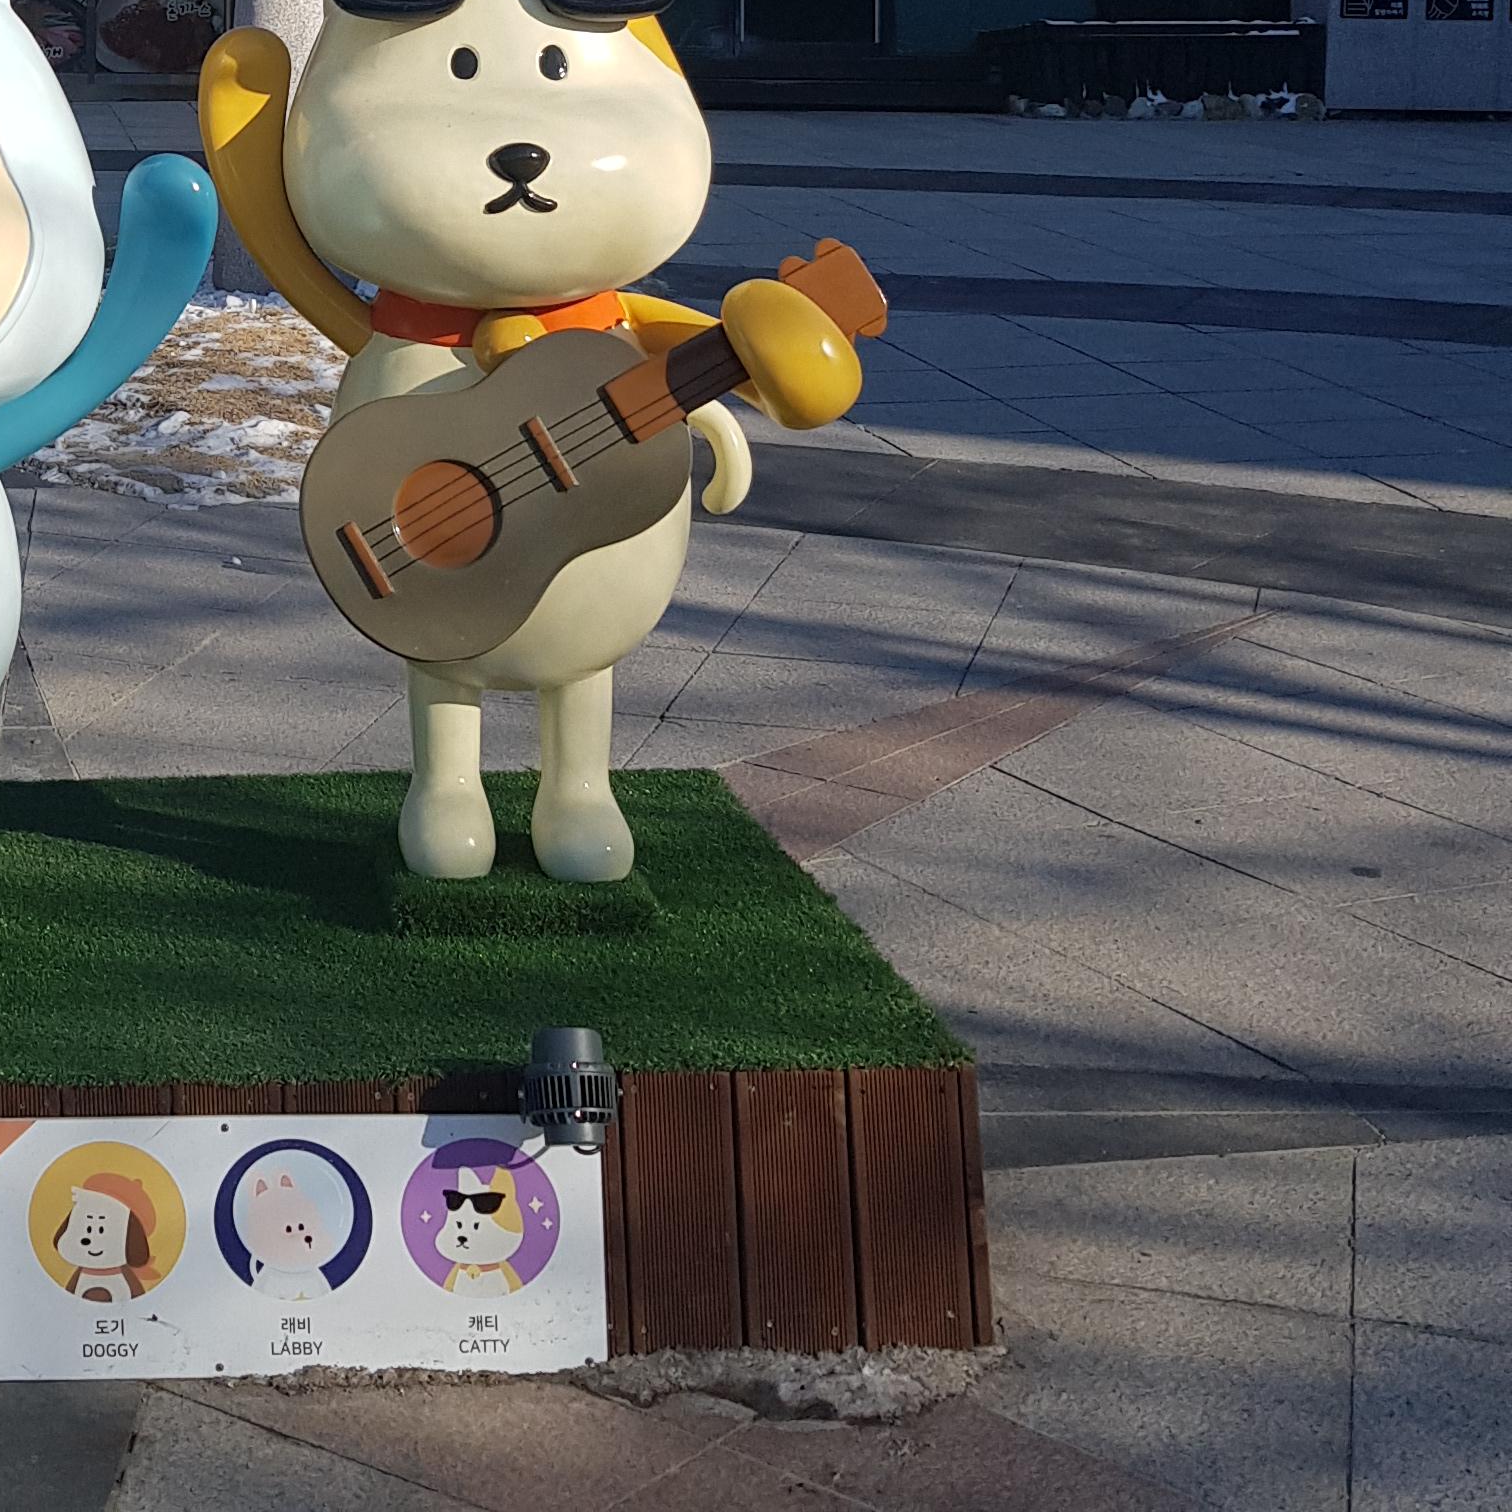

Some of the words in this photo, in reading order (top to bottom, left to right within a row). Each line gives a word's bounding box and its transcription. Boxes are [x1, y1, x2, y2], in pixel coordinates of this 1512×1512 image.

[94, 1319, 126, 1337] 도기
[280, 1317, 311, 1336] 래비
[467, 1315, 499, 1333] 캐티
[82, 1342, 140, 1359] DOGGY
[271, 1341, 324, 1357] LABBY
[458, 1338, 511, 1355] CATTY
